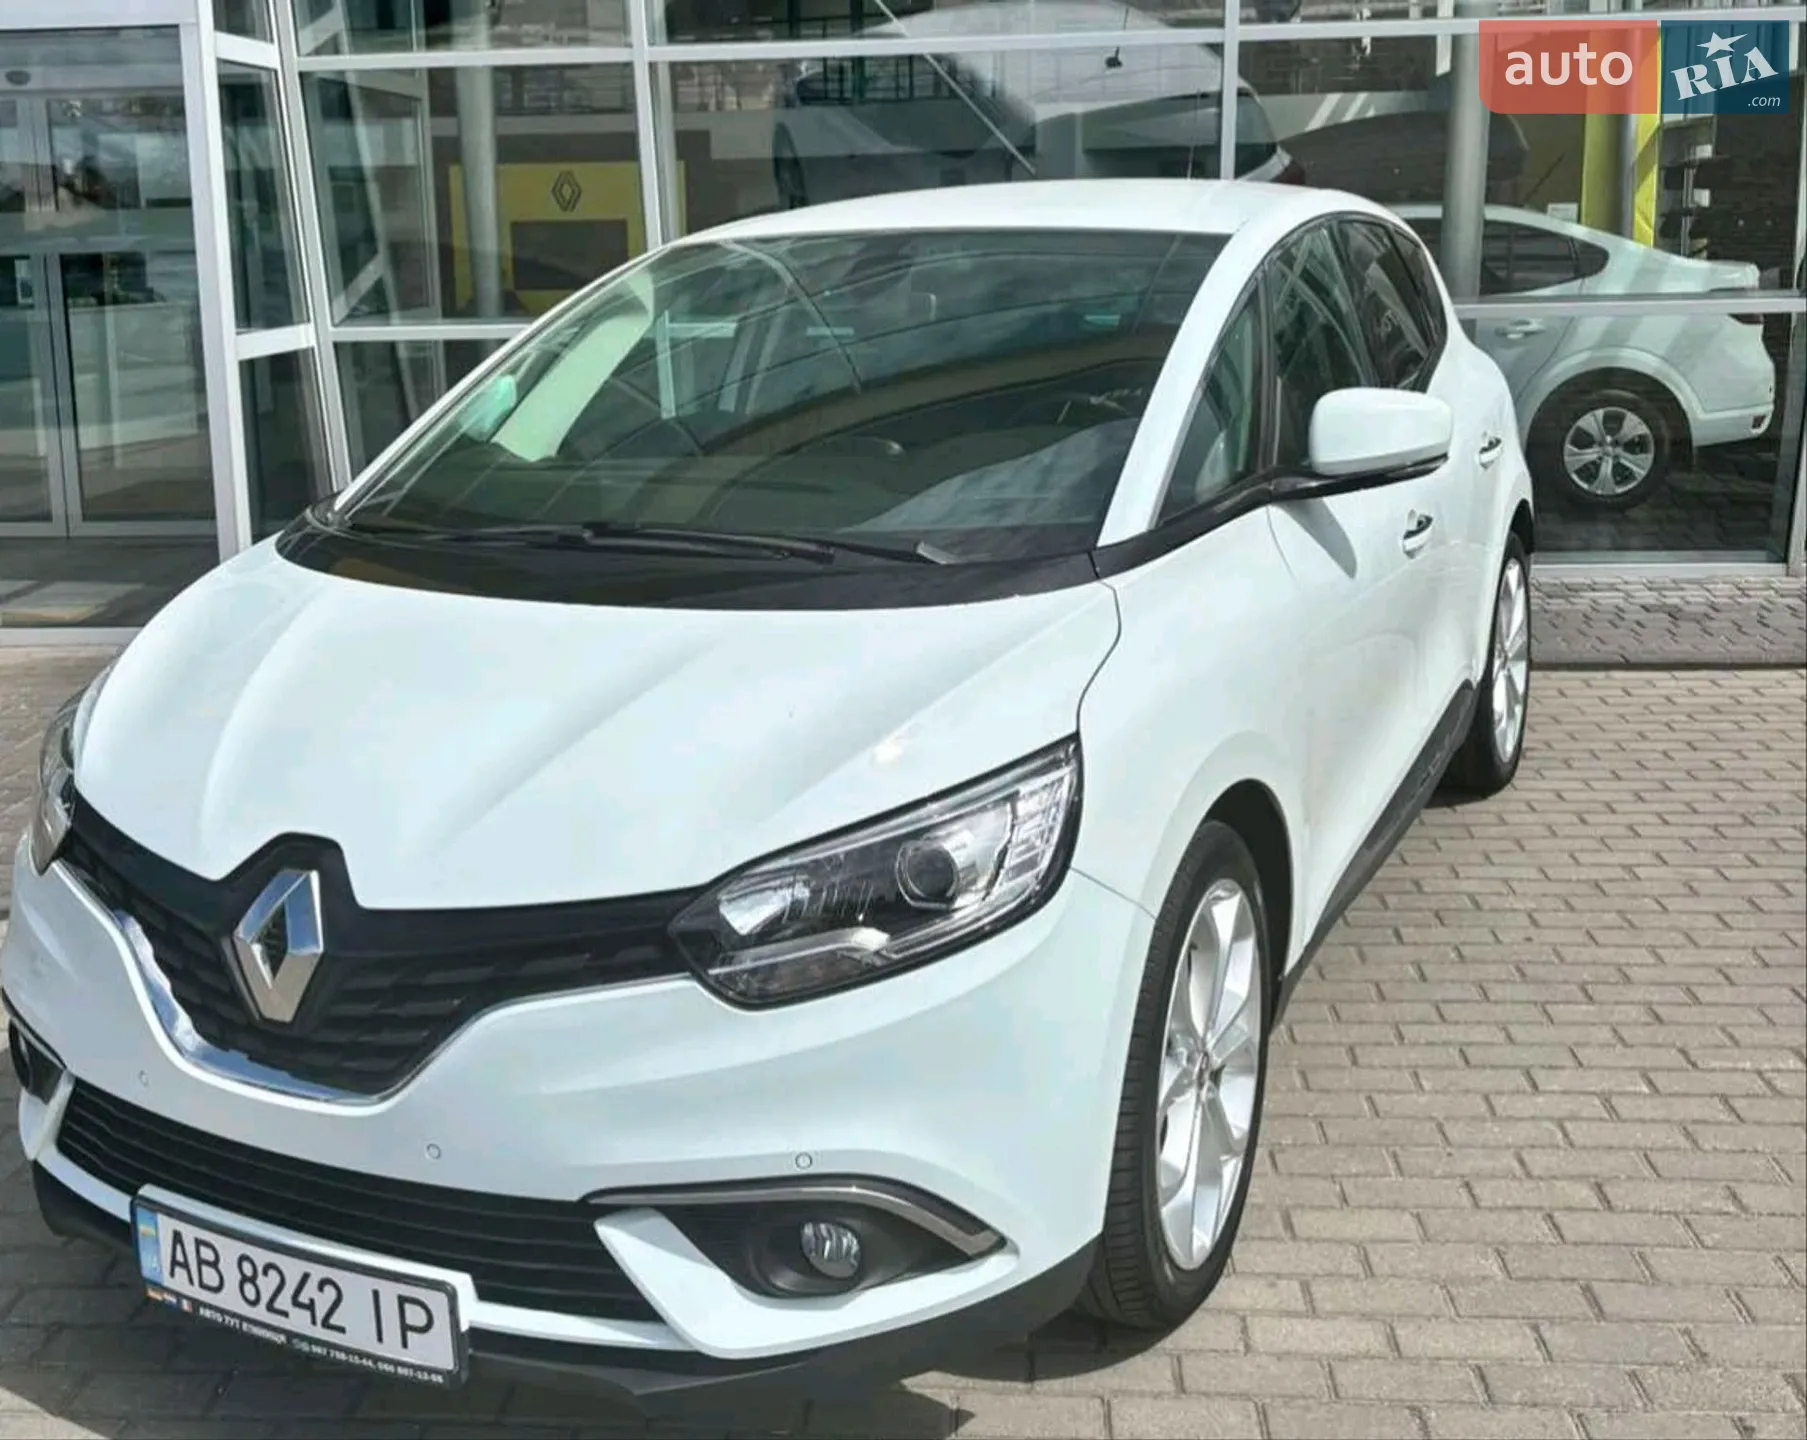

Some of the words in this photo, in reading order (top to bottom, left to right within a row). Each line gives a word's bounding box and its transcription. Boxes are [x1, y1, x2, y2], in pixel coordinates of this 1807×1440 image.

[169, 1229, 225, 1294] AB
[236, 1254, 347, 1334] 8242
[371, 1288, 435, 1349] IP
